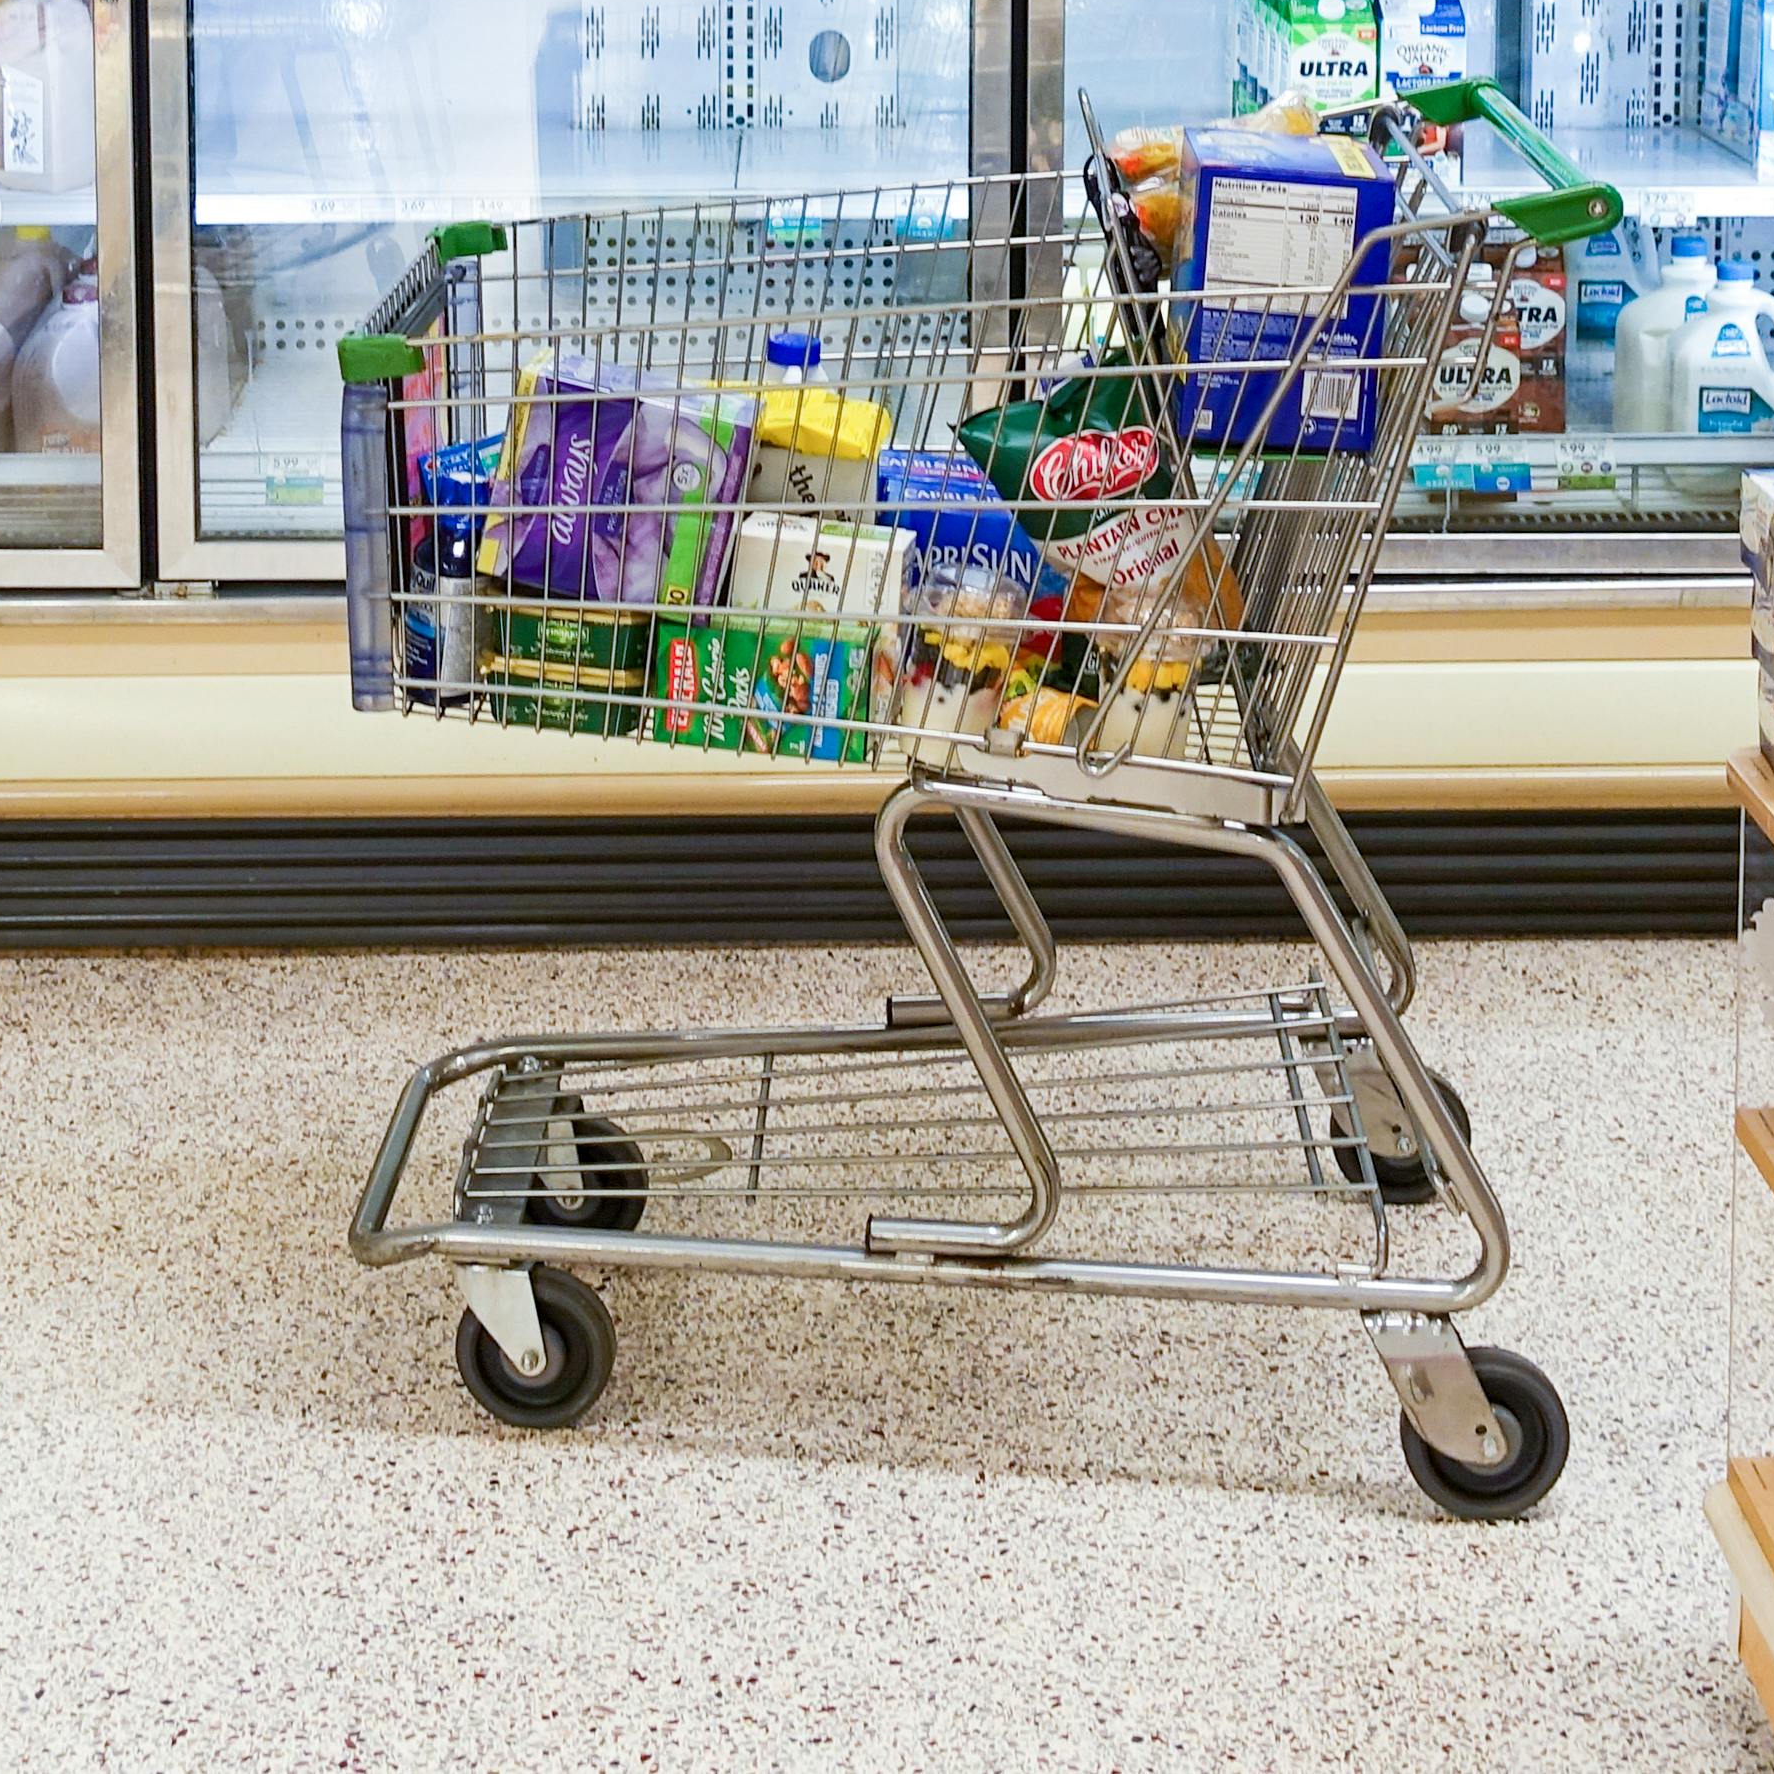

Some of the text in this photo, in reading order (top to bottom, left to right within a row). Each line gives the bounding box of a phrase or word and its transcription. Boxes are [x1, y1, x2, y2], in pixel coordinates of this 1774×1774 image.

[1396, 42, 1449, 58] ORGANIC
[1300, 61, 1368, 76] ULTRA
[1214, 179, 1286, 194] Nutrition Facts
[1213, 209, 1247, 218] Calories
[1439, 367, 1512, 385] ULTRA
[1702, 392, 1750, 410] Lactaid
[552, 433, 599, 546] always
[789, 464, 816, 504] the
[1057, 508, 1186, 560] PLANTAIN CHI
[972, 544, 1032, 583] SUN
[1111, 539, 1180, 586] Original
[792, 581, 841, 596] QUAKER
[671, 644, 695, 726] EERALD
